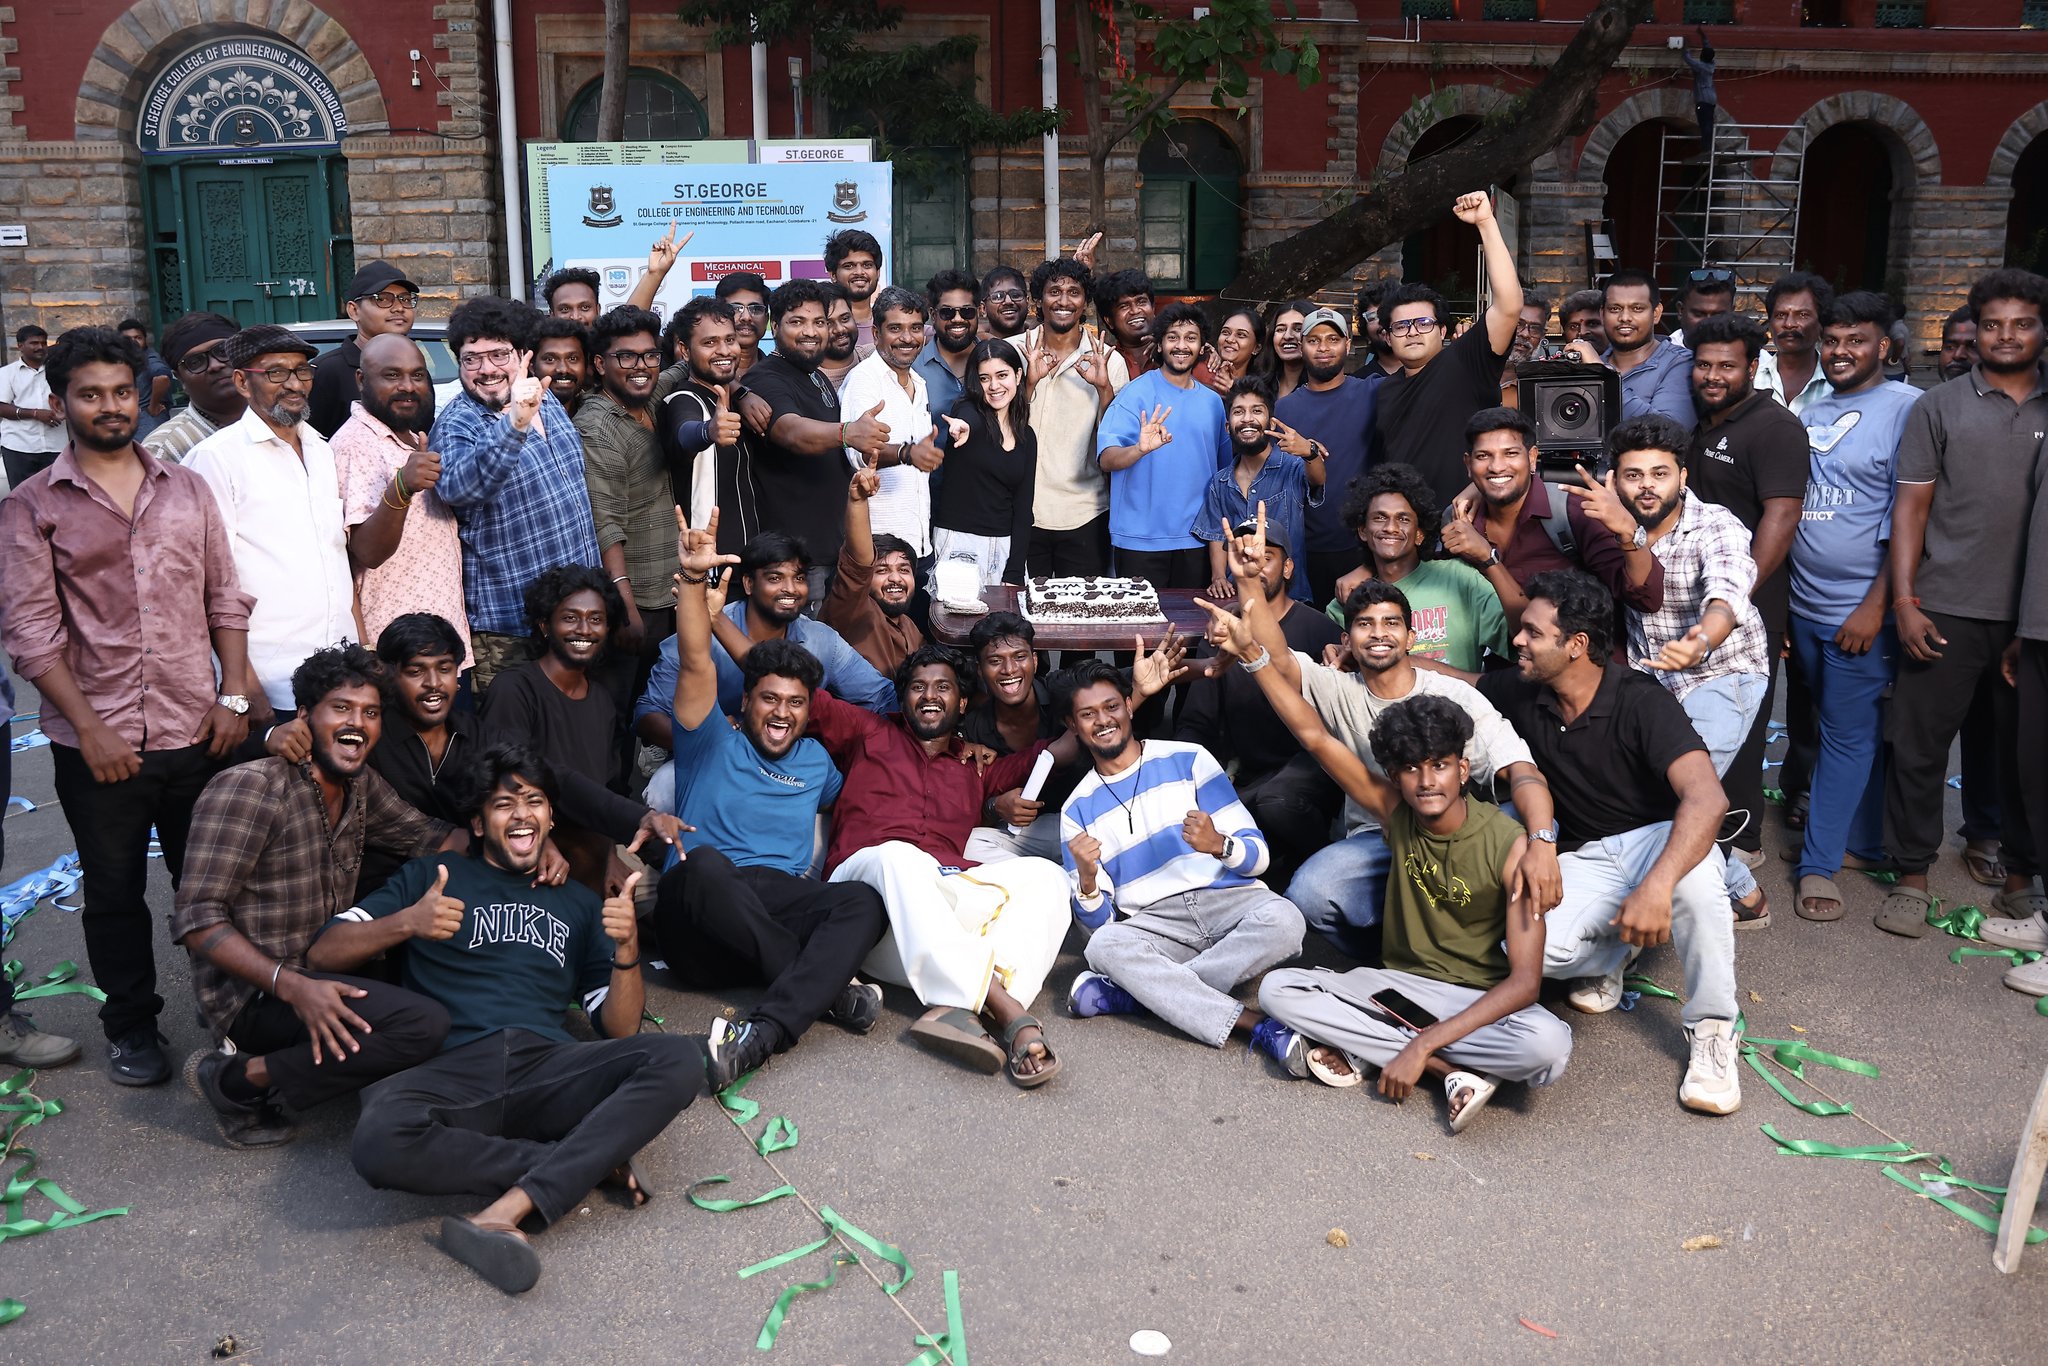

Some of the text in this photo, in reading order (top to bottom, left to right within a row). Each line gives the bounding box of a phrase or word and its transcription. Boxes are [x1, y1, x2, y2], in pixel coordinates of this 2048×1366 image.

[145, 43, 348, 136] ST.GEORGE COLLEGE OF ENGINEERING AND TECHNOLOGY
[785, 149, 845, 160] ST.GEORGE
[673, 182, 768, 199] ST.GEORGE
[637, 205, 805, 218] COLLEGE OF ENGINEERING AND TECHNOLOGY
[703, 262, 765, 271] MECHANICAL
[1714, 451, 1734, 465] CAMERA
[1801, 510, 1836, 521] JUICY
[468, 902, 570, 968] NIKE
